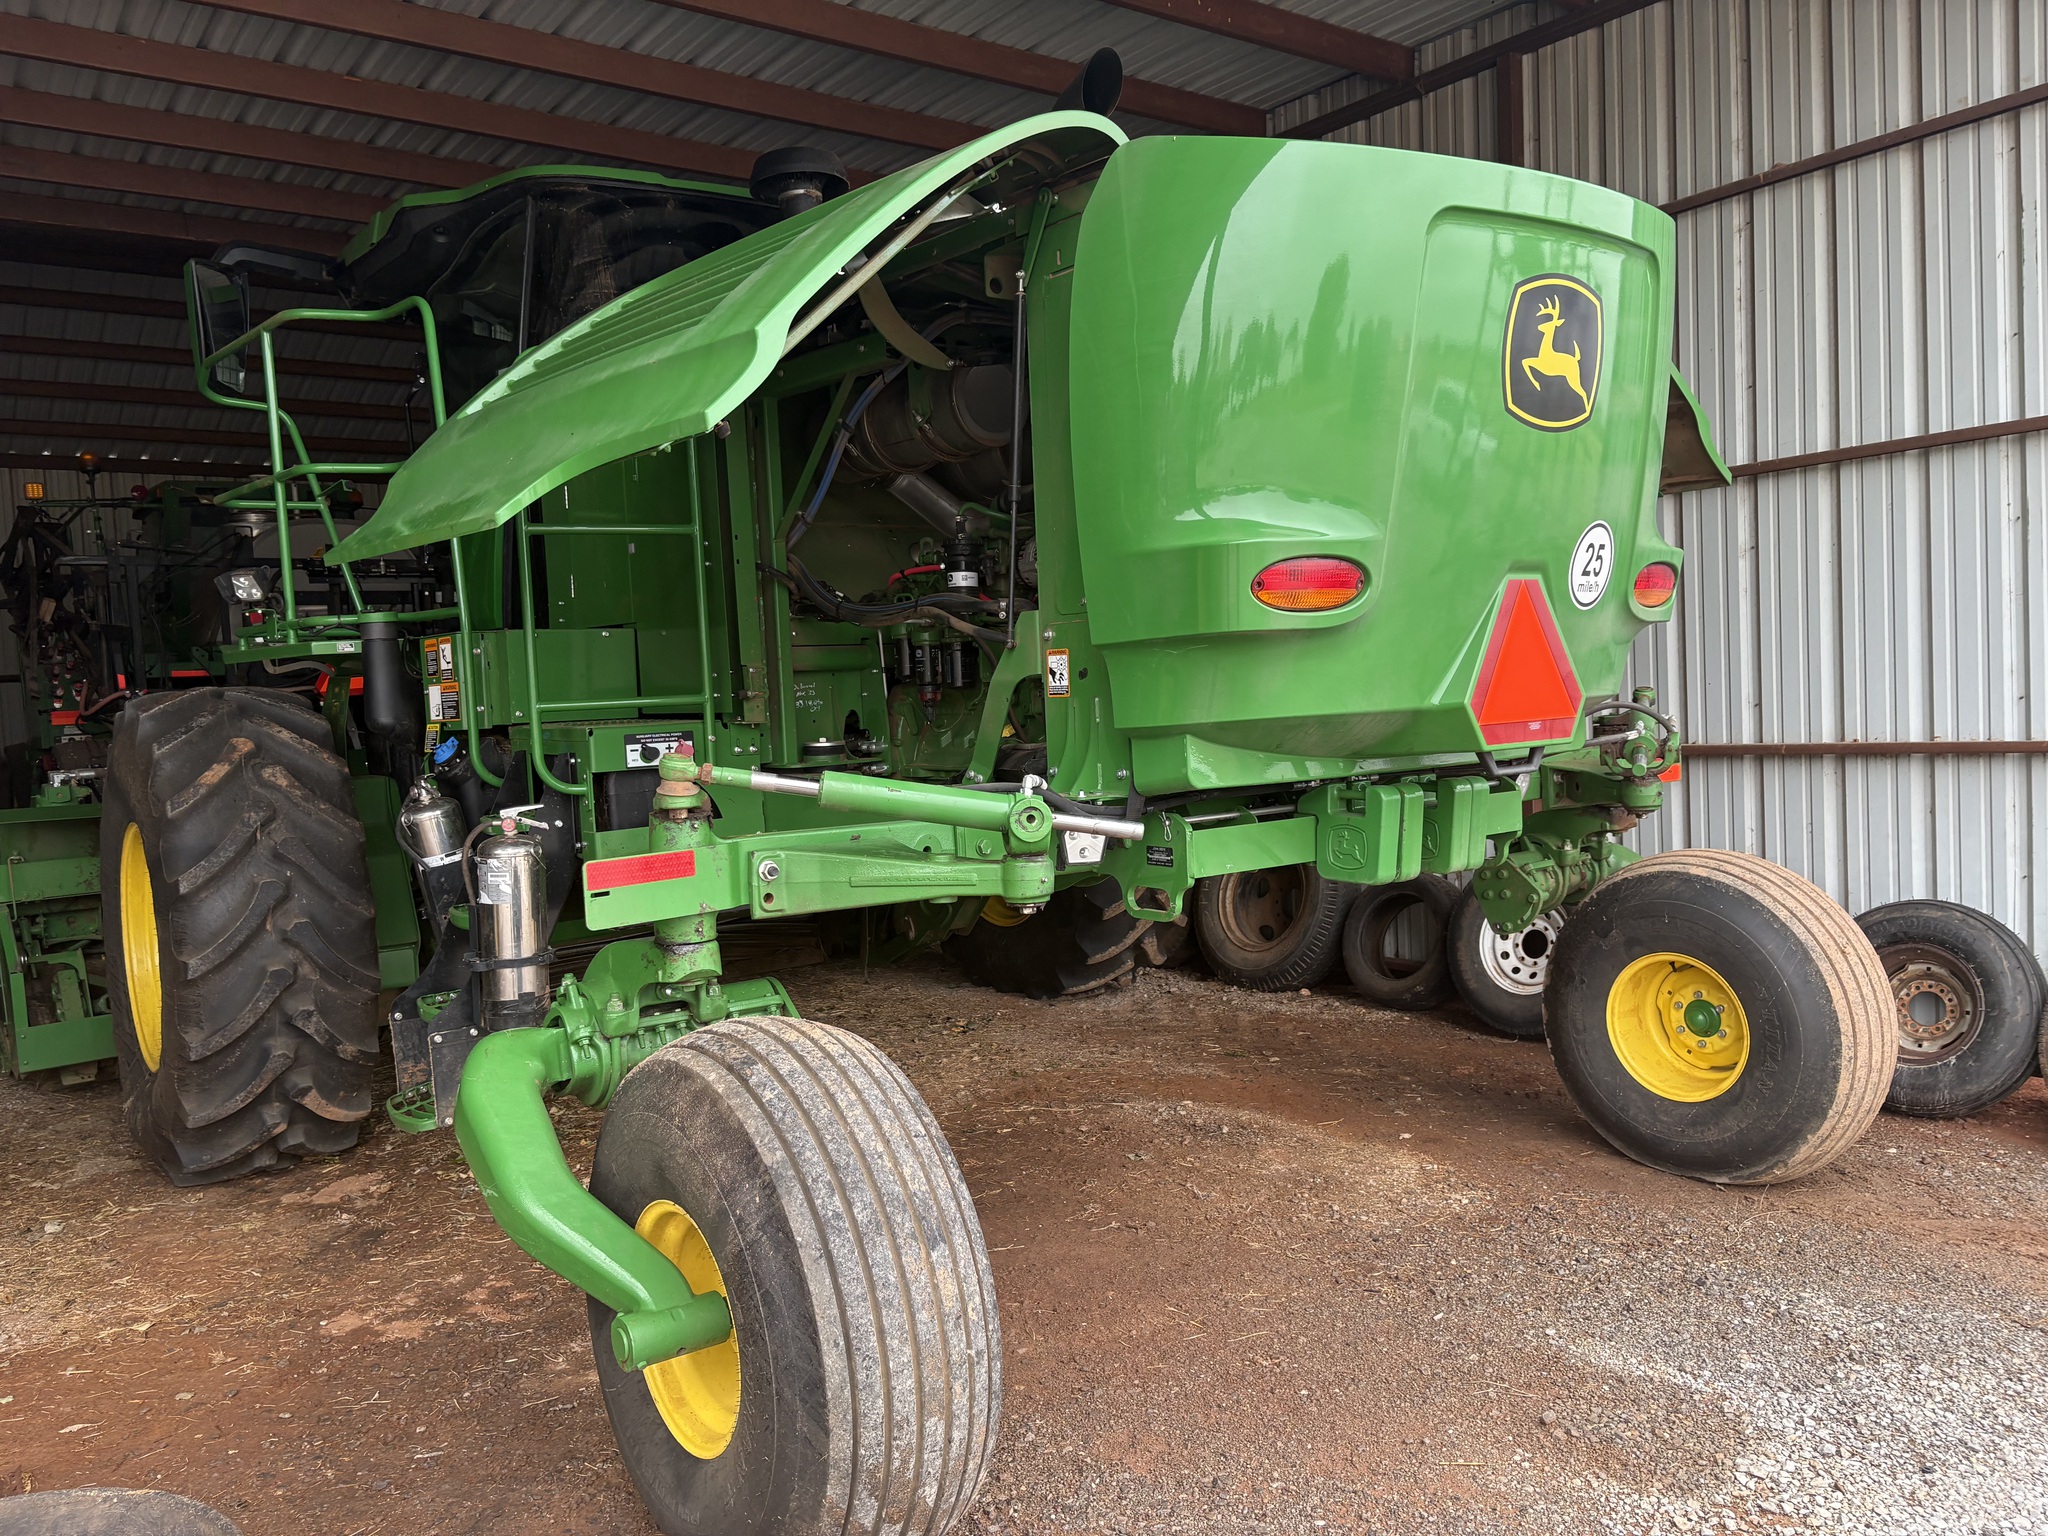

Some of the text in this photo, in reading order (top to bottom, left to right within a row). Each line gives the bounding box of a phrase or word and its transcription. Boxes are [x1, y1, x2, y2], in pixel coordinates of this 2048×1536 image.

[1581, 542, 1606, 577] 25
[1577, 581, 1600, 592] mile/h
[1757, 1008, 1783, 1096] TITAN
